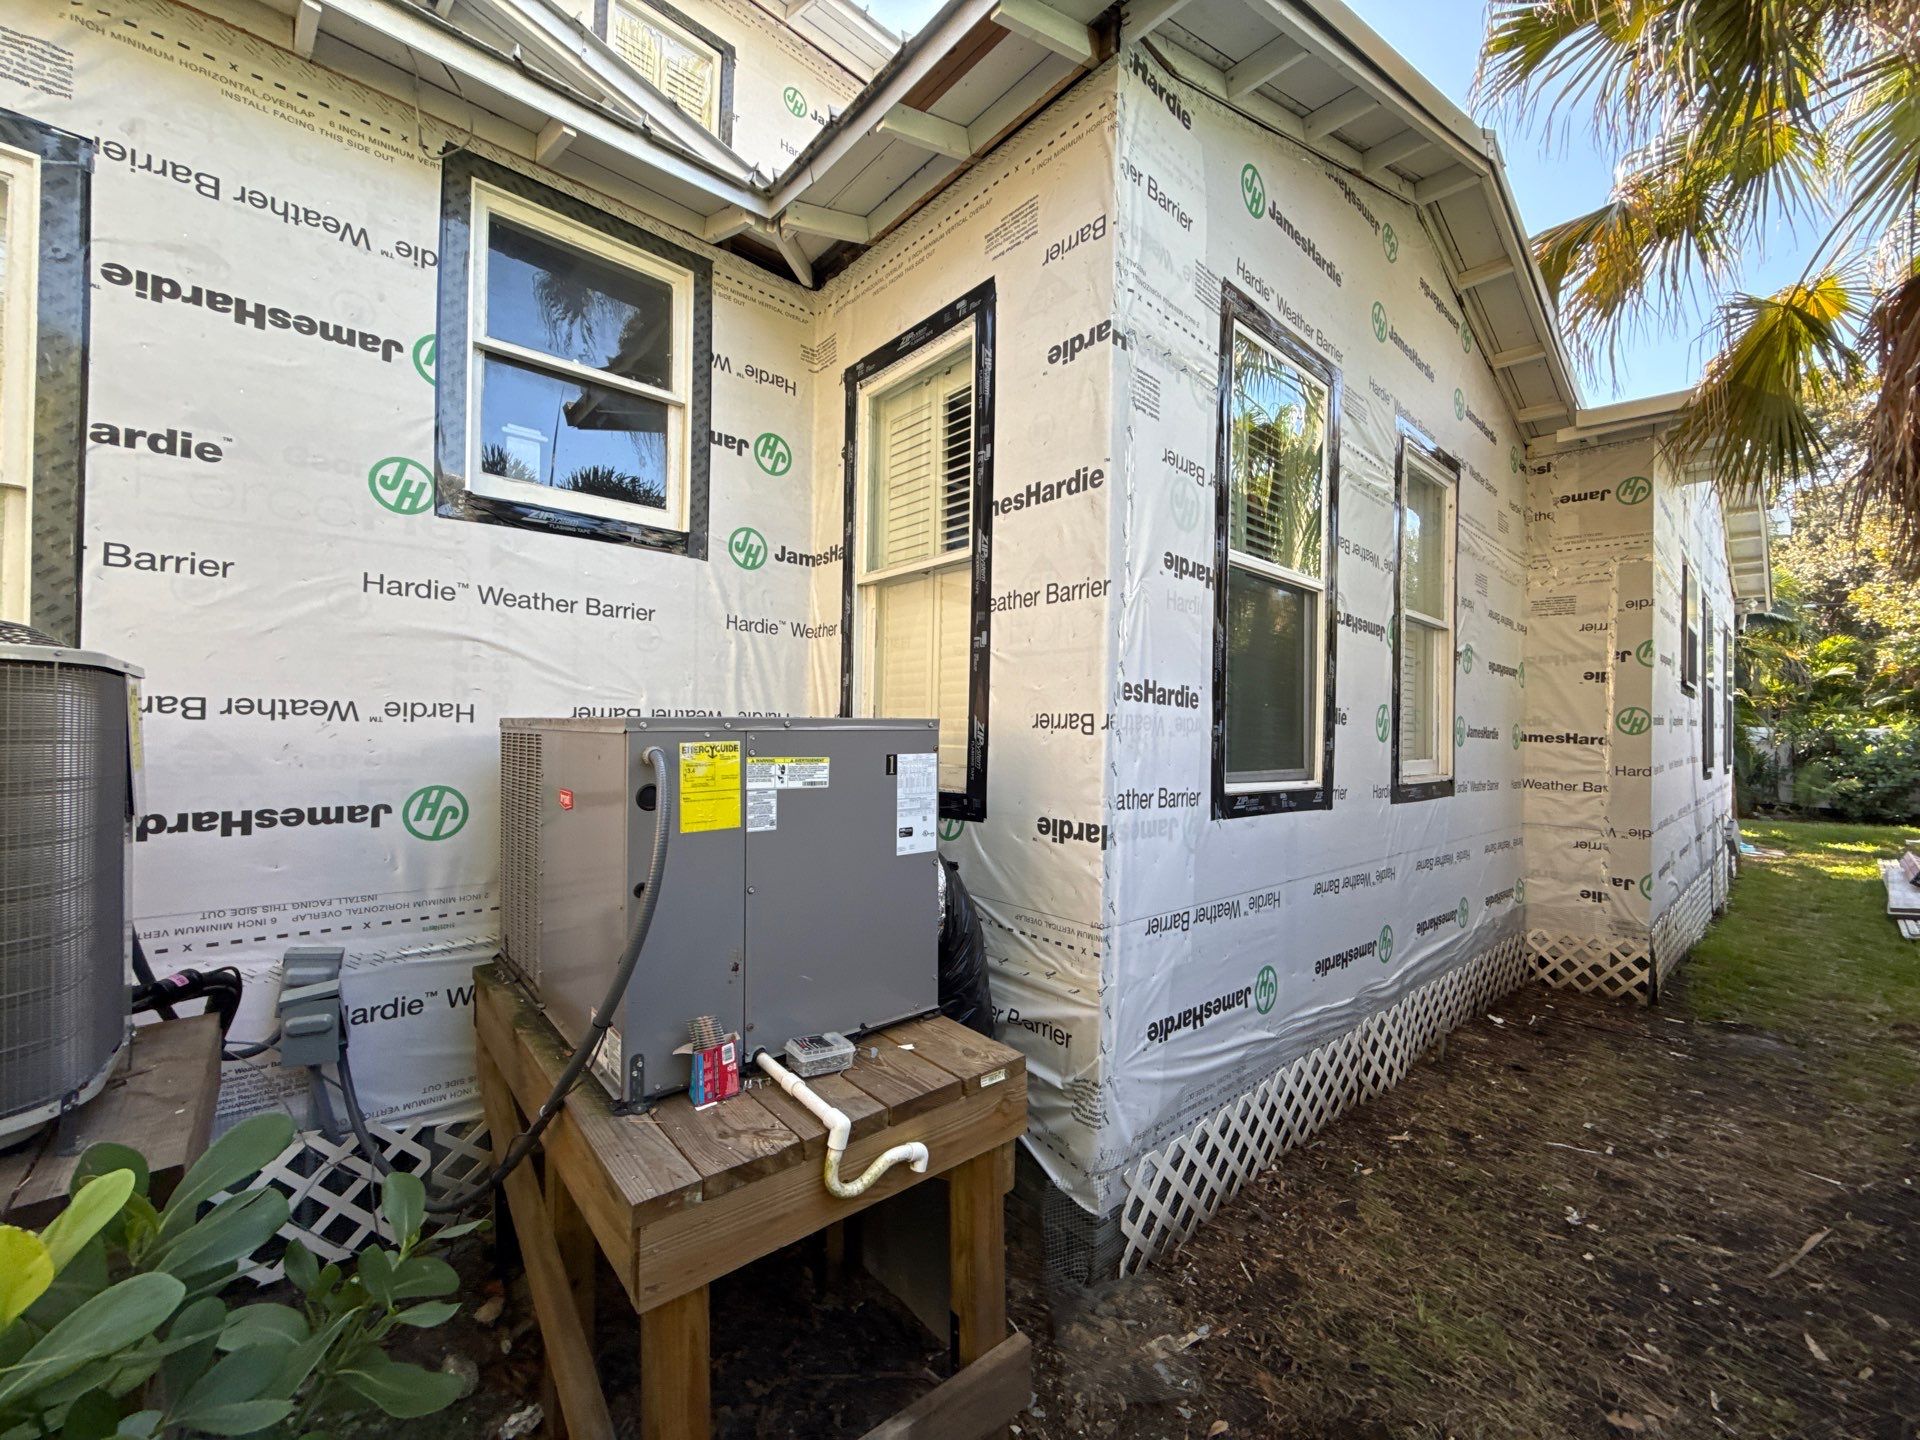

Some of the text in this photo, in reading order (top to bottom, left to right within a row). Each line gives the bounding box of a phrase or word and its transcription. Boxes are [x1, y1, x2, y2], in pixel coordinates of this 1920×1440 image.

[70, 14, 105, 36] INCH
[110, 31, 175, 62] MINIMUM
[179, 58, 259, 98] HORIZONTAL
[262, 93, 315, 118] OVERLAP
[338, 124, 365, 141] INCH
[368, 136, 415, 160] MINIMUM
[221, 88, 395, 163] INSTALL FACING THIS SIDE OUT
[1036, 157, 1053, 172] INCH
[1053, 134, 1085, 160] MINIMUM
[1148, 174, 1193, 232] Barrier
[233, 185, 371, 252] Weather
[1241, 163, 1343, 288] JH JamesHardie
[1042, 214, 1107, 267] Barrier
[1277, 293, 1315, 339] Weather
[1316, 328, 1344, 365] Barrier
[755, 433, 792, 476] JH
[1162, 448, 1205, 487] Barrier
[370, 457, 435, 515] JH
[1616, 476, 1653, 506] JH
[102, 541, 235, 579] Barrier
[729, 527, 767, 570] JH
[477, 585, 578, 614] Weather
[586, 597, 656, 622] Barrier
[1046, 577, 1112, 604] Barrier
[791, 621, 838, 639] Weather
[219, 696, 359, 723] Weather
[1616, 707, 1652, 735] JH
[1032, 713, 1095, 735] Barrier
[888, 755, 895, 774] 1
[1158, 787, 1201, 809] Barrier
[1522, 778, 1577, 791] Weather
[402, 785, 469, 841] JH
[459, 893, 481, 903] INCH
[1313, 872, 1371, 897] Weather Barrier
[200, 894, 378, 920] INSTALL FACING THIS SIDE OUT
[291, 909, 342, 922] OVERLAP
[346, 901, 410, 916] HORIZONTAL
[413, 897, 456, 908] MINIMUM
[1193, 900, 1241, 924] Weather
[174, 922, 233, 936] MINIMUM
[237, 919, 267, 929] INCH
[271, 917, 277, 925] 6
[1145, 911, 1190, 937] Barrier
[1314, 940, 1377, 976] JamesHardie
[1007, 1008, 1072, 1048] Barrier
[1147, 986, 1251, 1043] JamesHardie
[422, 1078, 465, 1094] SIDE OUT
[403, 1093, 447, 1110] MINIMUM
